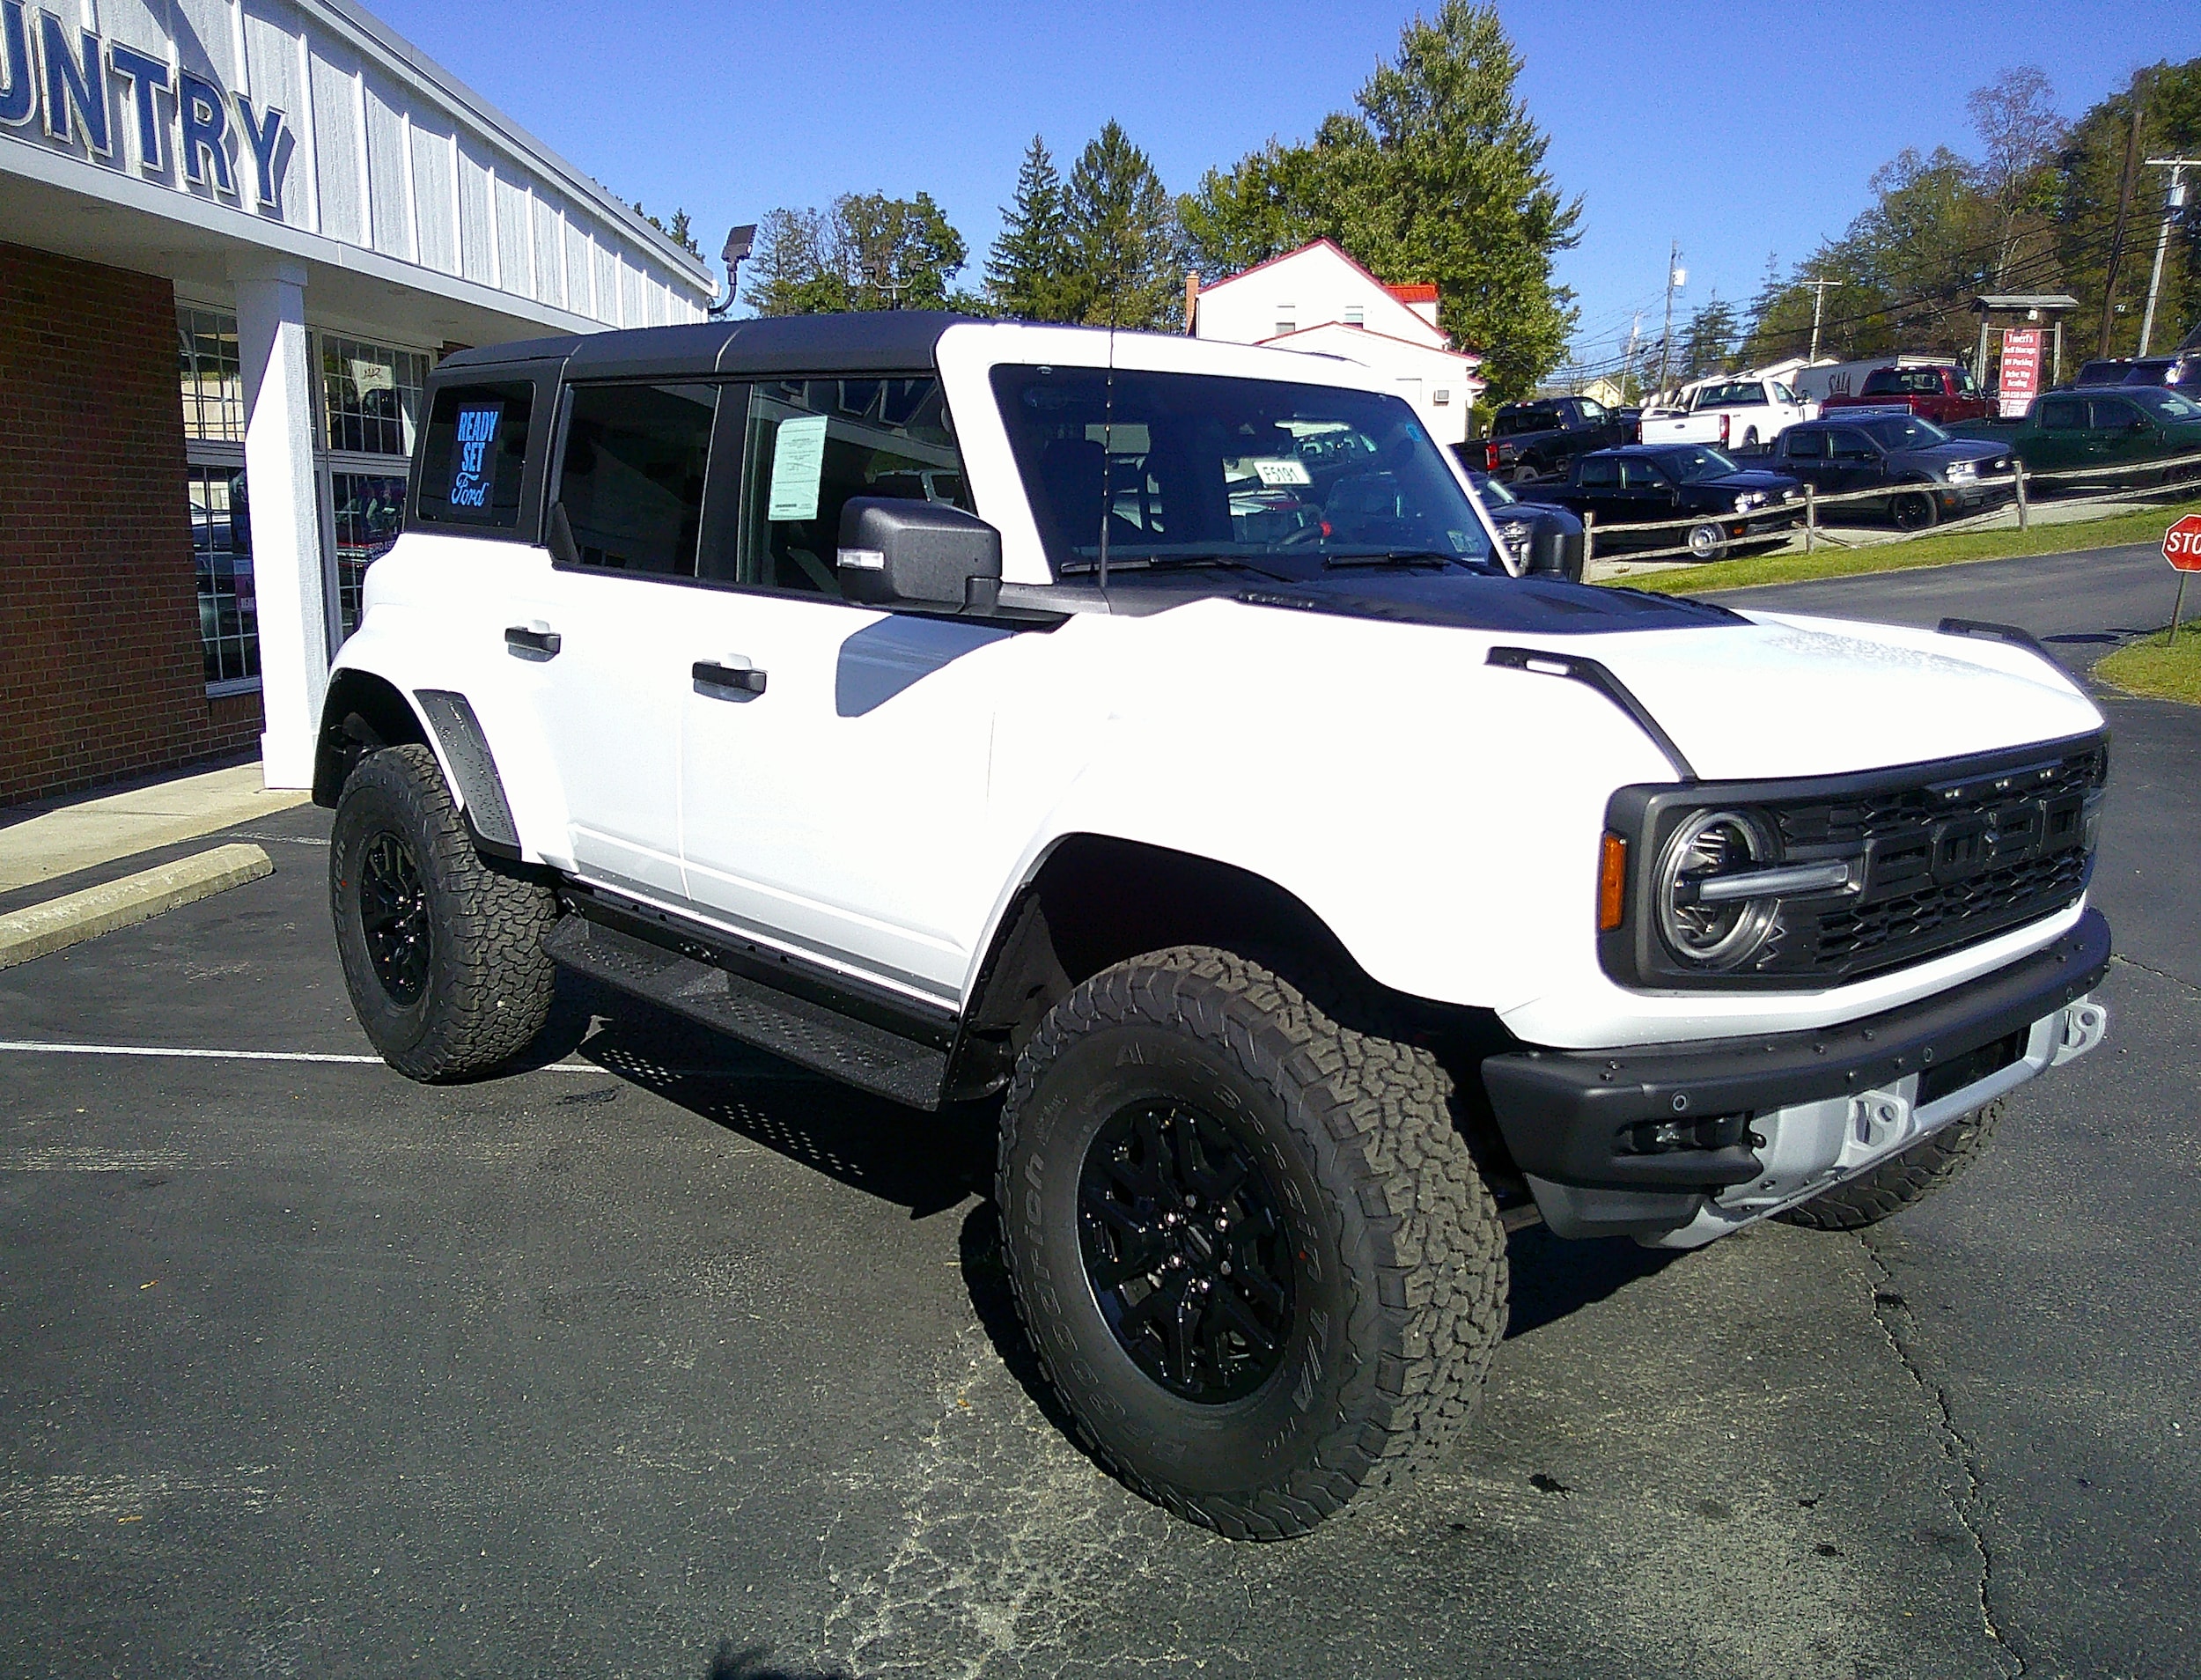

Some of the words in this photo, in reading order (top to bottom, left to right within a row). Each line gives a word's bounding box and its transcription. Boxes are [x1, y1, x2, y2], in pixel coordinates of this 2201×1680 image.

[457, 411, 499, 442] READY
[461, 441, 486, 473] SET
[451, 472, 490, 508] Ford
[1262, 467, 1300, 483] F5191
